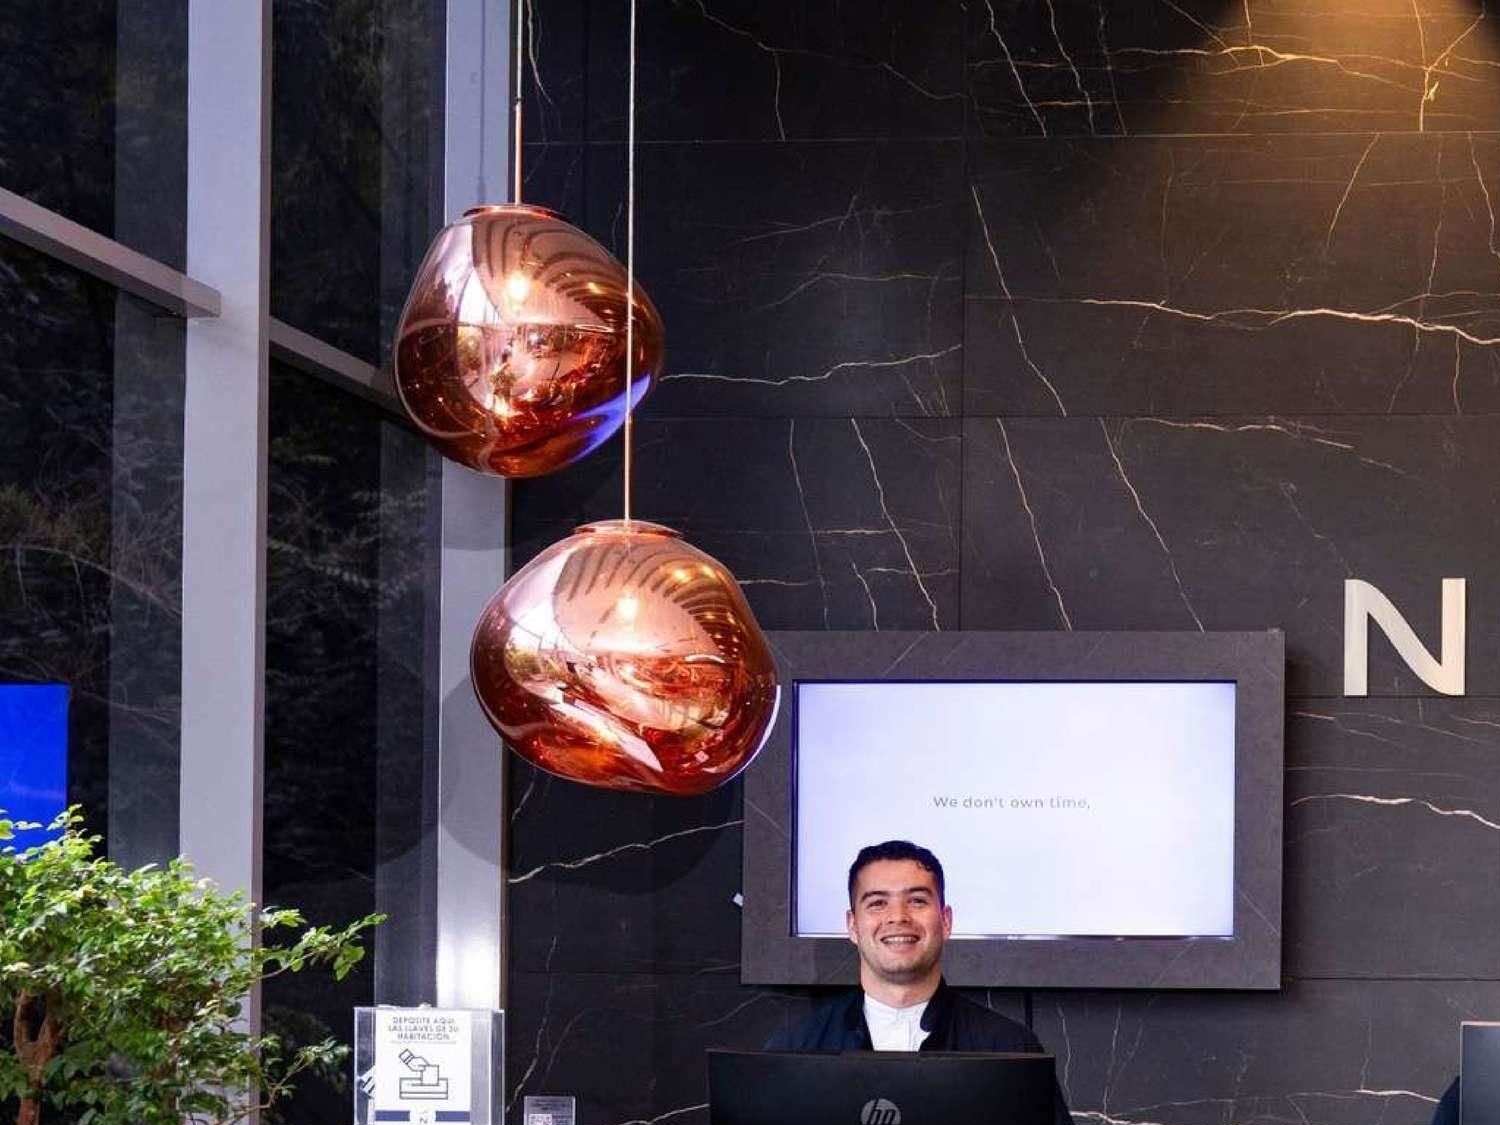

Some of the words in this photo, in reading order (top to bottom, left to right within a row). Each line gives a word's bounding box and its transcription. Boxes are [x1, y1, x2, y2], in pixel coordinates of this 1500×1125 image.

[933, 797, 957, 808] We
[963, 796, 1004, 808] don't
[1010, 799, 1043, 808] own
